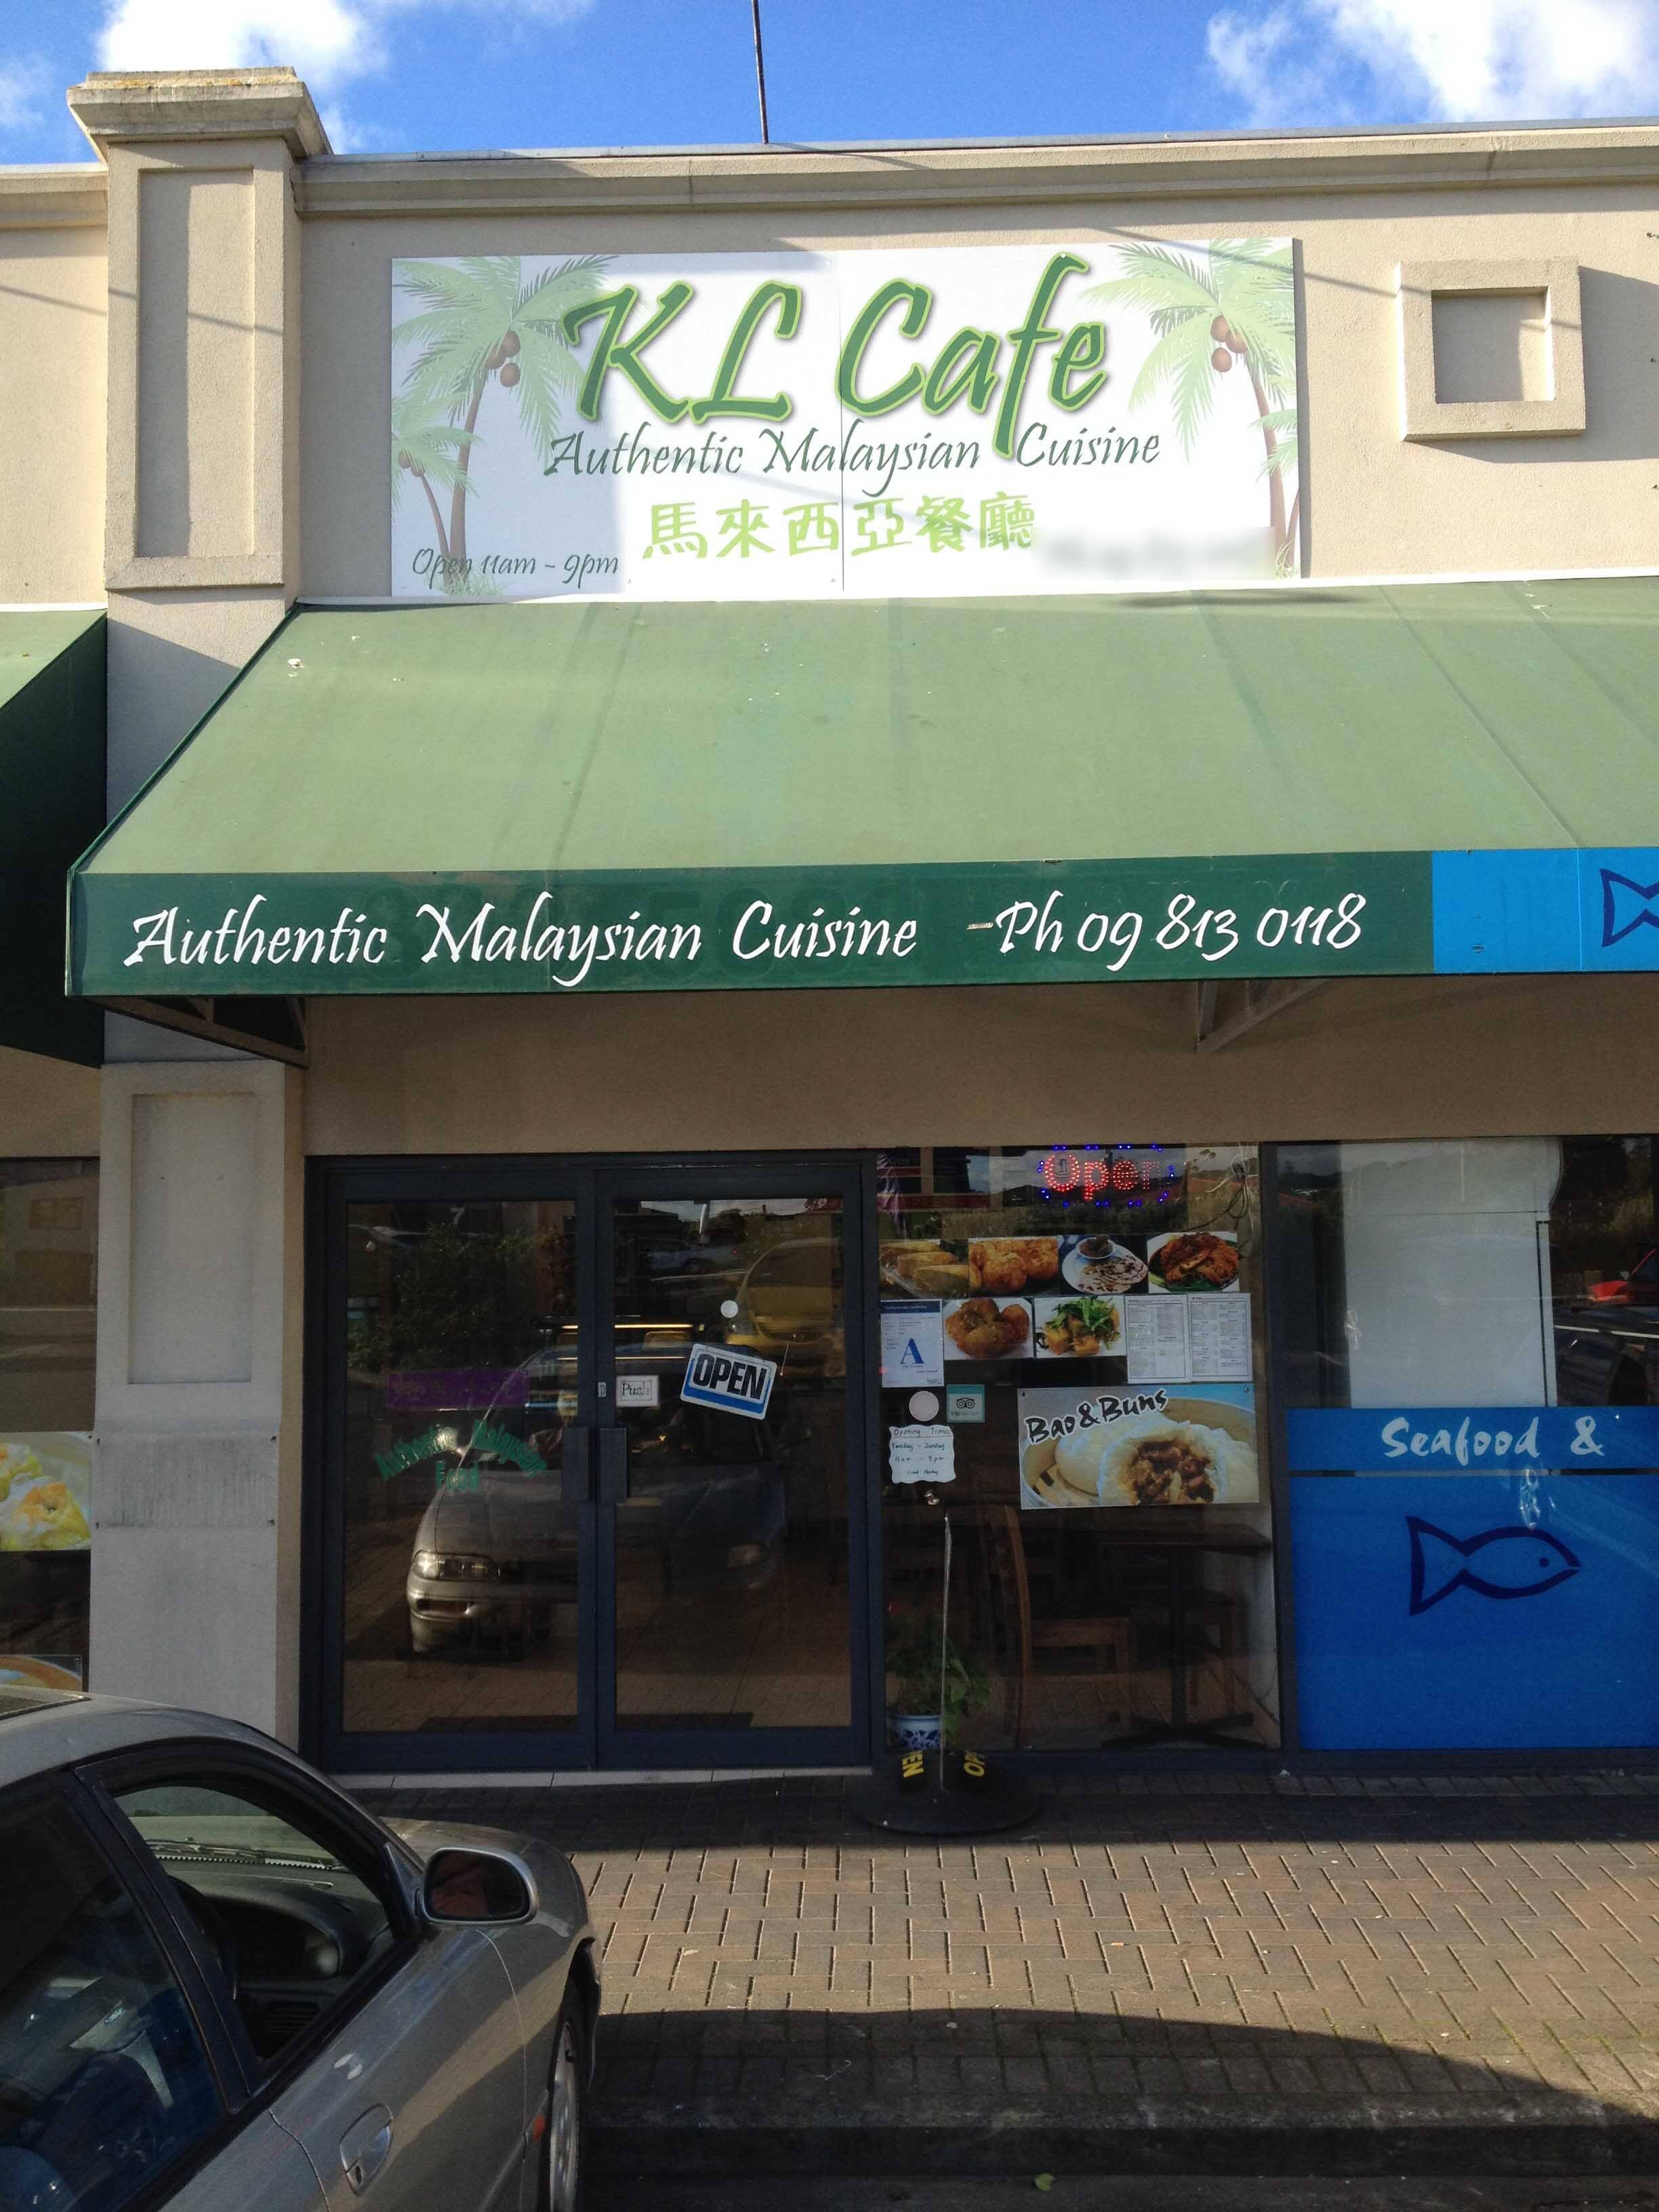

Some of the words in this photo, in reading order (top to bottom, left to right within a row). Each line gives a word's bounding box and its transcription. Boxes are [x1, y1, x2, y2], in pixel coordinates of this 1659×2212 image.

[559, 279, 802, 424] KL
[834, 251, 1110, 459] Cafe
[543, 420, 743, 476] Authentic
[758, 417, 980, 497] Malaysian
[1016, 422, 1161, 468] Cuisine
[642, 491, 1036, 558] 馬來西亞餐廳
[411, 548, 472, 590] Open
[480, 554, 537, 575] 11am
[562, 554, 619, 590] 9pm
[123, 894, 388, 967] Authentic
[415, 890, 703, 987] Malaysian
[732, 899, 917, 960] Cuisine
[1077, 912, 1143, 972] 09
[1155, 893, 1239, 962] 813
[1256, 892, 1367, 949] 0118
[899, 1337, 927, 1365] A
[622, 1381, 650, 1397] Push
[693, 1353, 767, 1400] OPEN
[893, 1428, 921, 1437] Opening
[1380, 1416, 1540, 1467] Seafood
[1570, 1415, 1605, 1456] &
